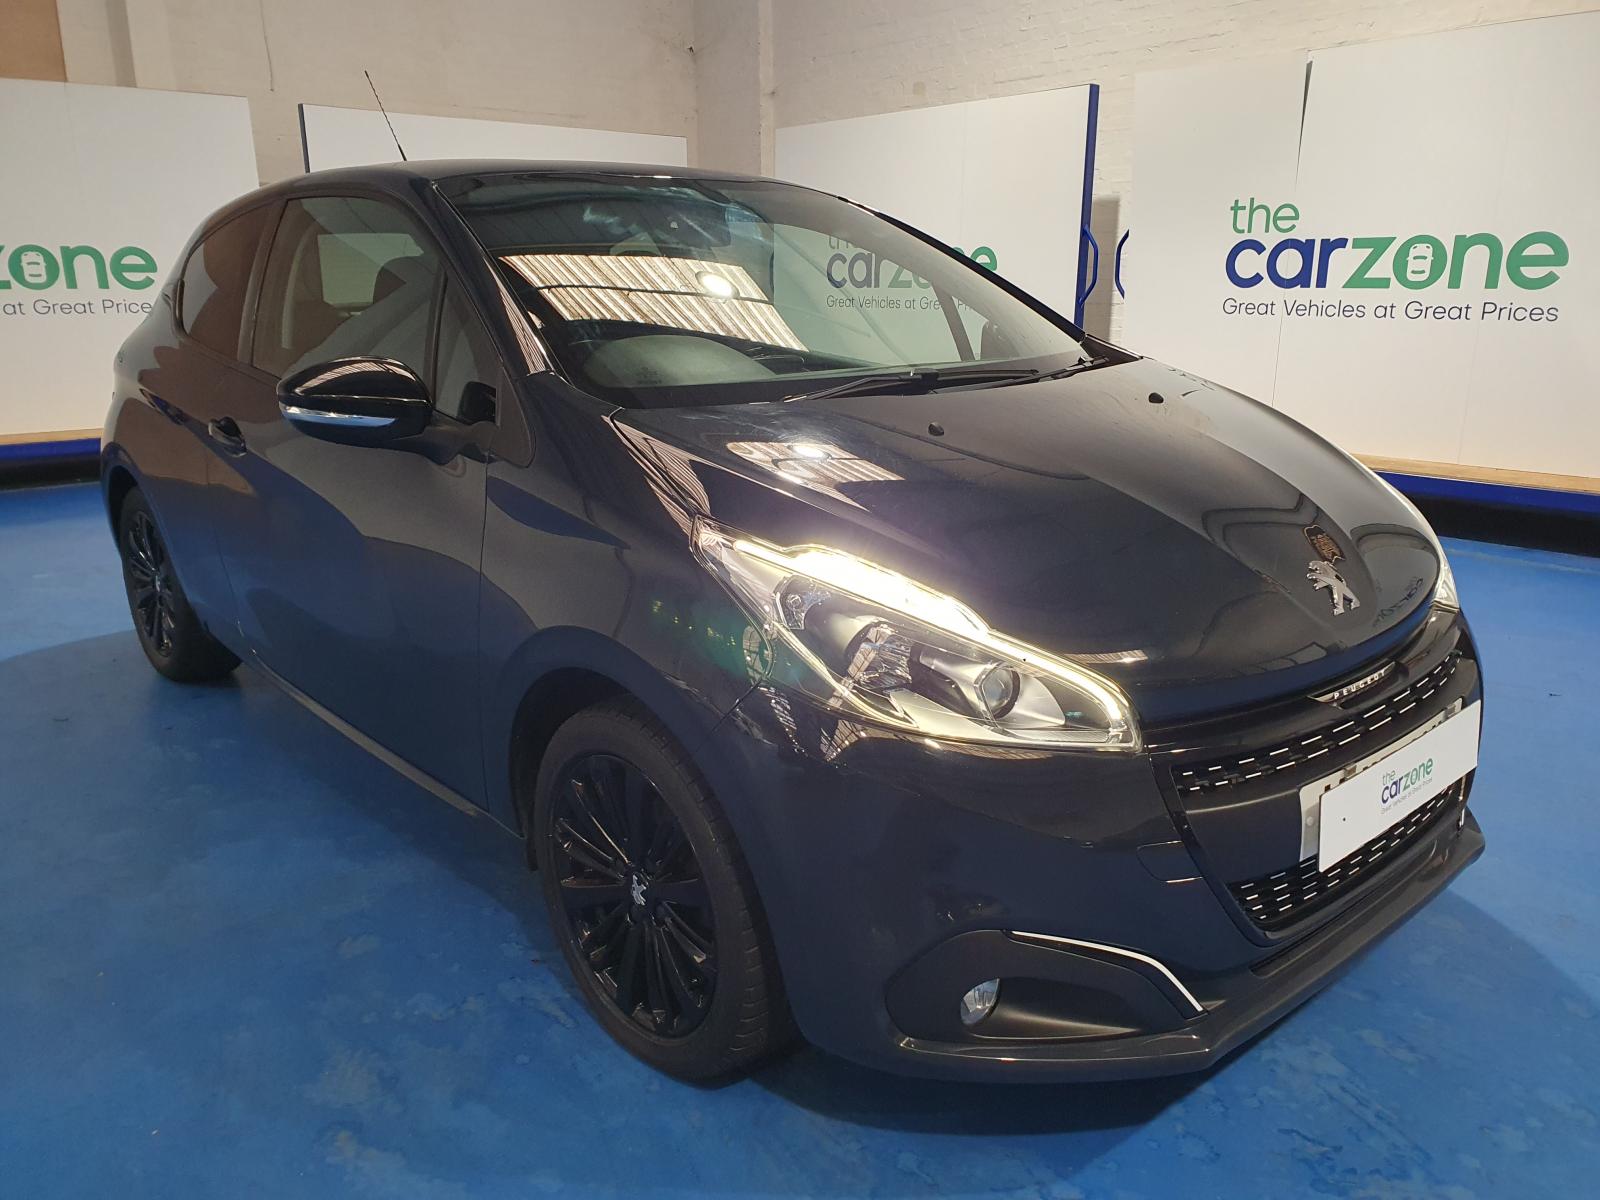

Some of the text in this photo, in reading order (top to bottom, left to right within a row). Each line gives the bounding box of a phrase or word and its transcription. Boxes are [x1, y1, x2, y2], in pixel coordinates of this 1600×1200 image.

[1230, 197, 1300, 234] the
[0, 243, 158, 291] one
[1225, 231, 1570, 290] carzone
[2, 301, 26, 316] at
[33, 298, 95, 315] Great
[827, 295, 855, 308] Great
[858, 296, 901, 309] Vehicles
[904, 299, 916, 309] at
[1222, 297, 1559, 322] Great Vehicles at Great Prices
[1333, 669, 1386, 700] PEUGEOT
[1381, 758, 1433, 804] carzone
[1382, 769, 1396, 786] the
